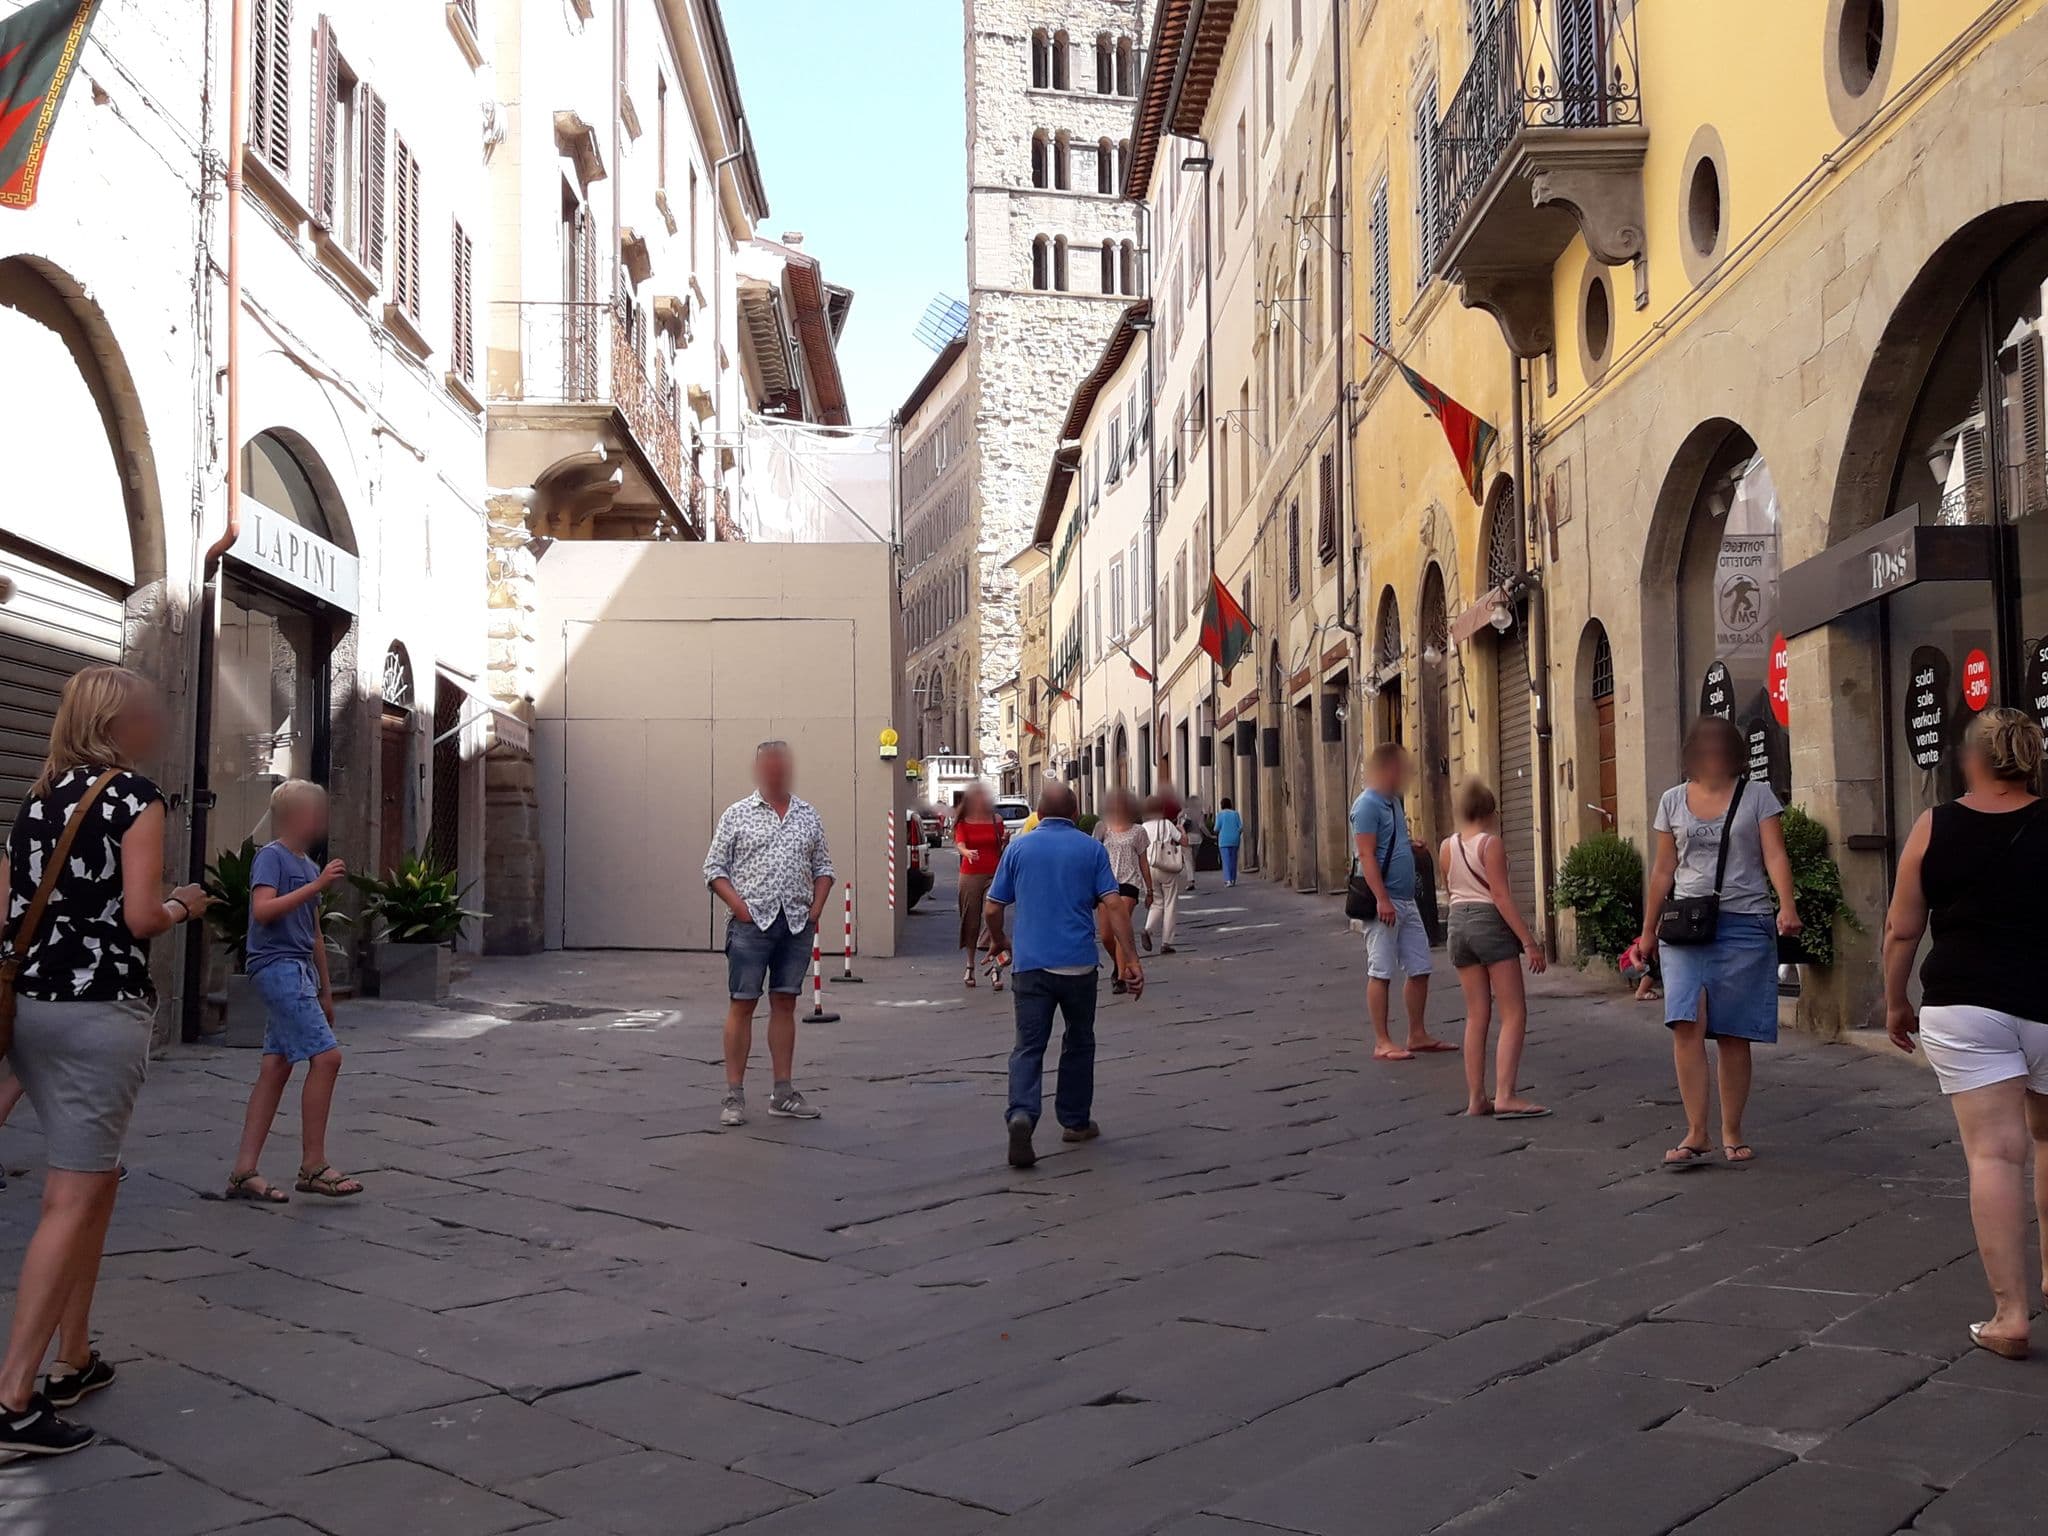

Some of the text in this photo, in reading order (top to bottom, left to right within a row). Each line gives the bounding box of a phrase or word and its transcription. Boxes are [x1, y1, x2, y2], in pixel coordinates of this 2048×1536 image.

[254, 514, 335, 592] LAPINI
[1775, 650, 1788, 669] no
[1968, 661, 1985, 676] now
[1915, 668, 1935, 688] saldi
[1709, 687, 1724, 705] sale
[1917, 690, 1934, 708] sale
[1912, 707, 1942, 729] verkauf
[1917, 749, 1939, 766] vente
